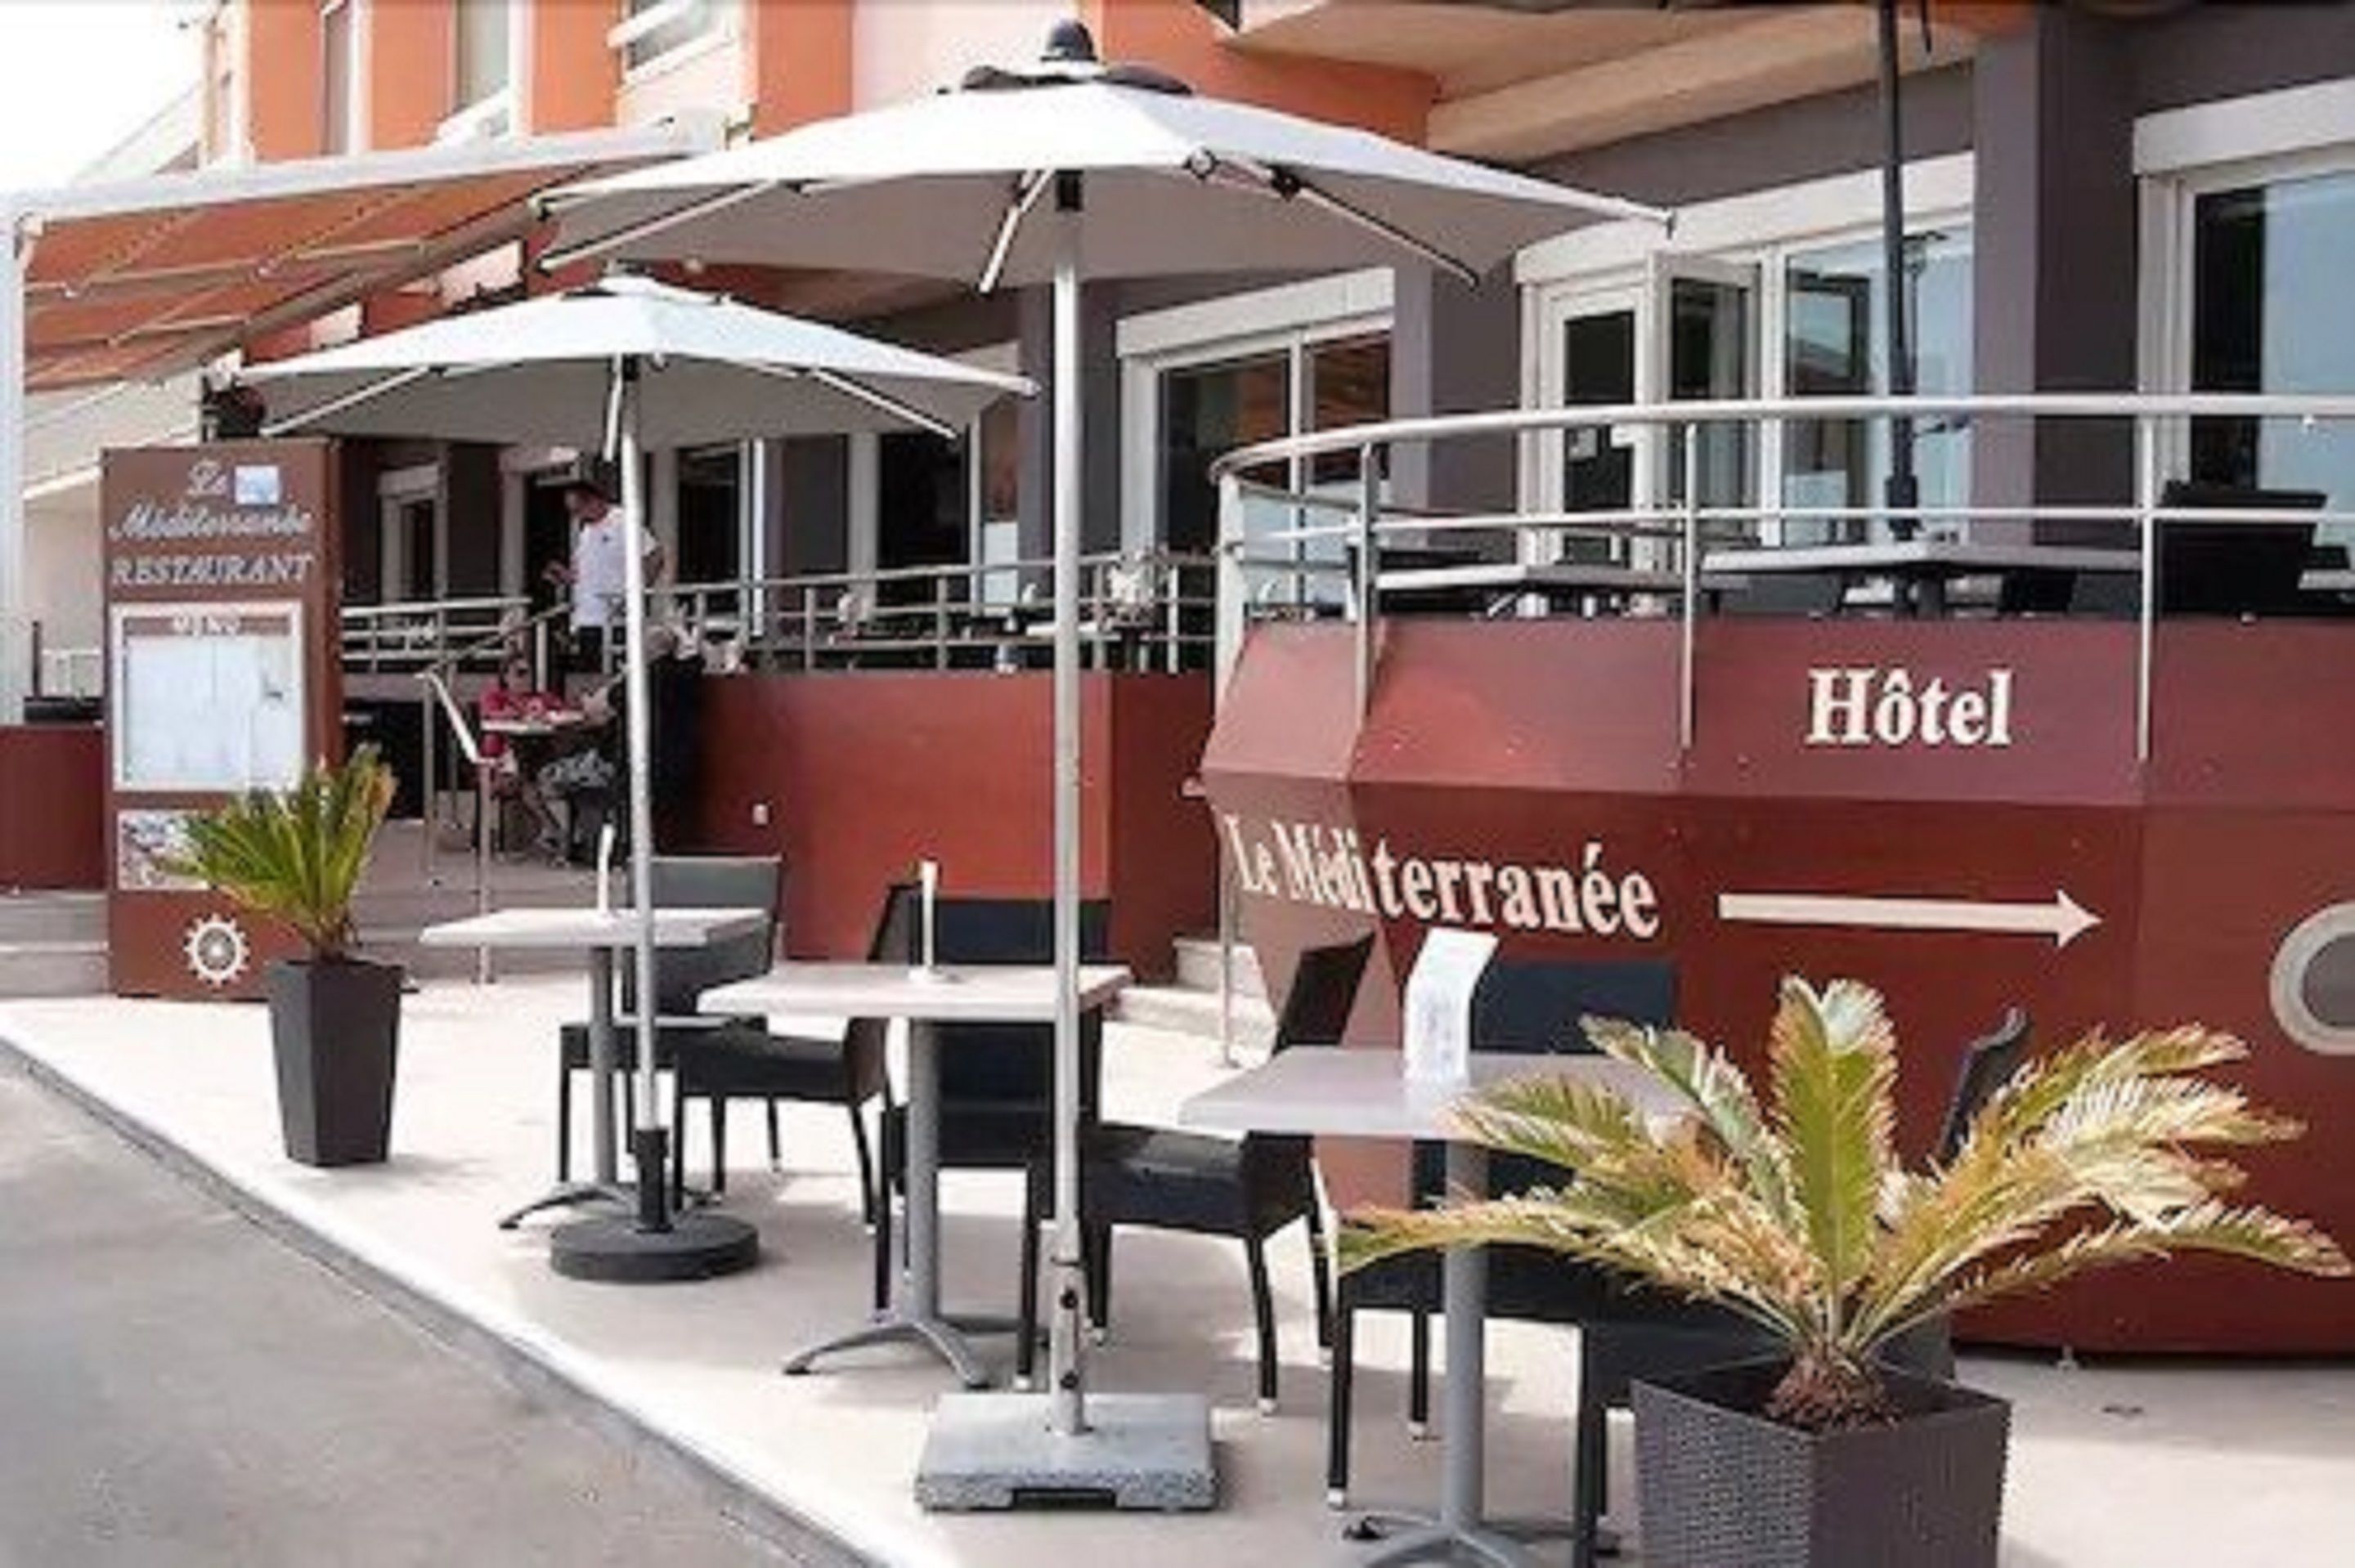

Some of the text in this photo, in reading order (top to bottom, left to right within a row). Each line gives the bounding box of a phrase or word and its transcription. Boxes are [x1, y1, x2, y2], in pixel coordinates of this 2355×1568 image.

[111, 553, 314, 585] RESTAURANT
[1805, 667, 2013, 746] Hôtel
[1225, 815, 1661, 939] Le Méditerranée
